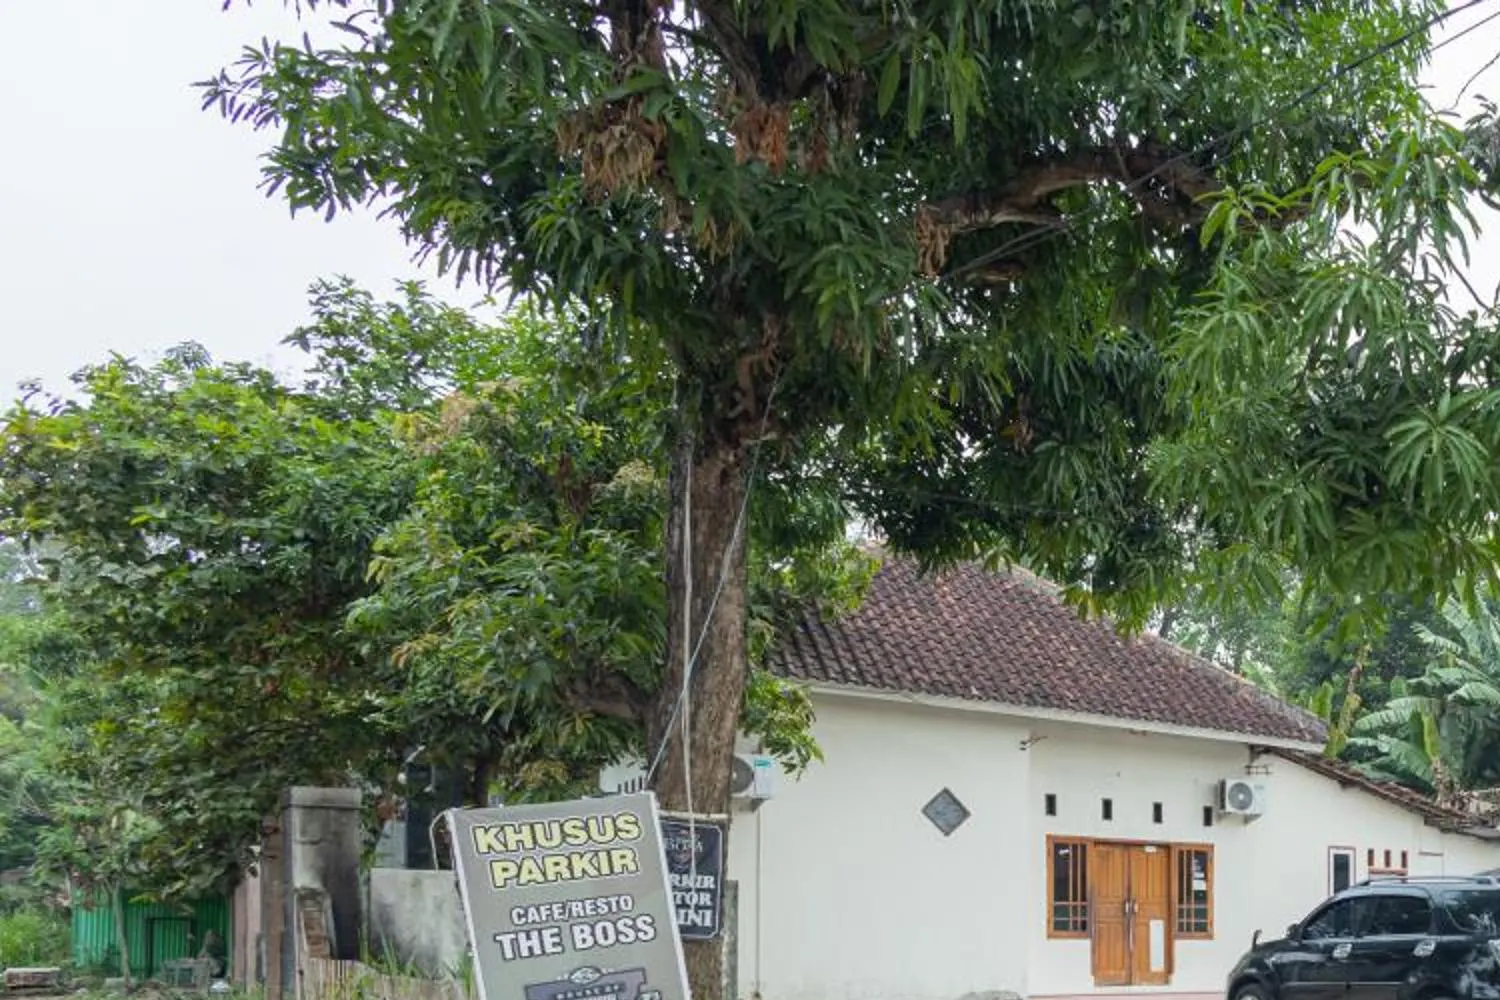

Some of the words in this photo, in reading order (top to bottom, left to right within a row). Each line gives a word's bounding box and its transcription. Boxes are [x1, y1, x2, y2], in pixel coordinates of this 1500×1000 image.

[473, 812, 643, 854] KHUSUS
[490, 847, 640, 888] PARKIR
[669, 873, 715, 889] RKIR
[510, 894, 634, 926] CAFE/RESTO
[672, 891, 713, 906] TOR
[494, 926, 564, 961] THE
[570, 914, 656, 950] BOSS
